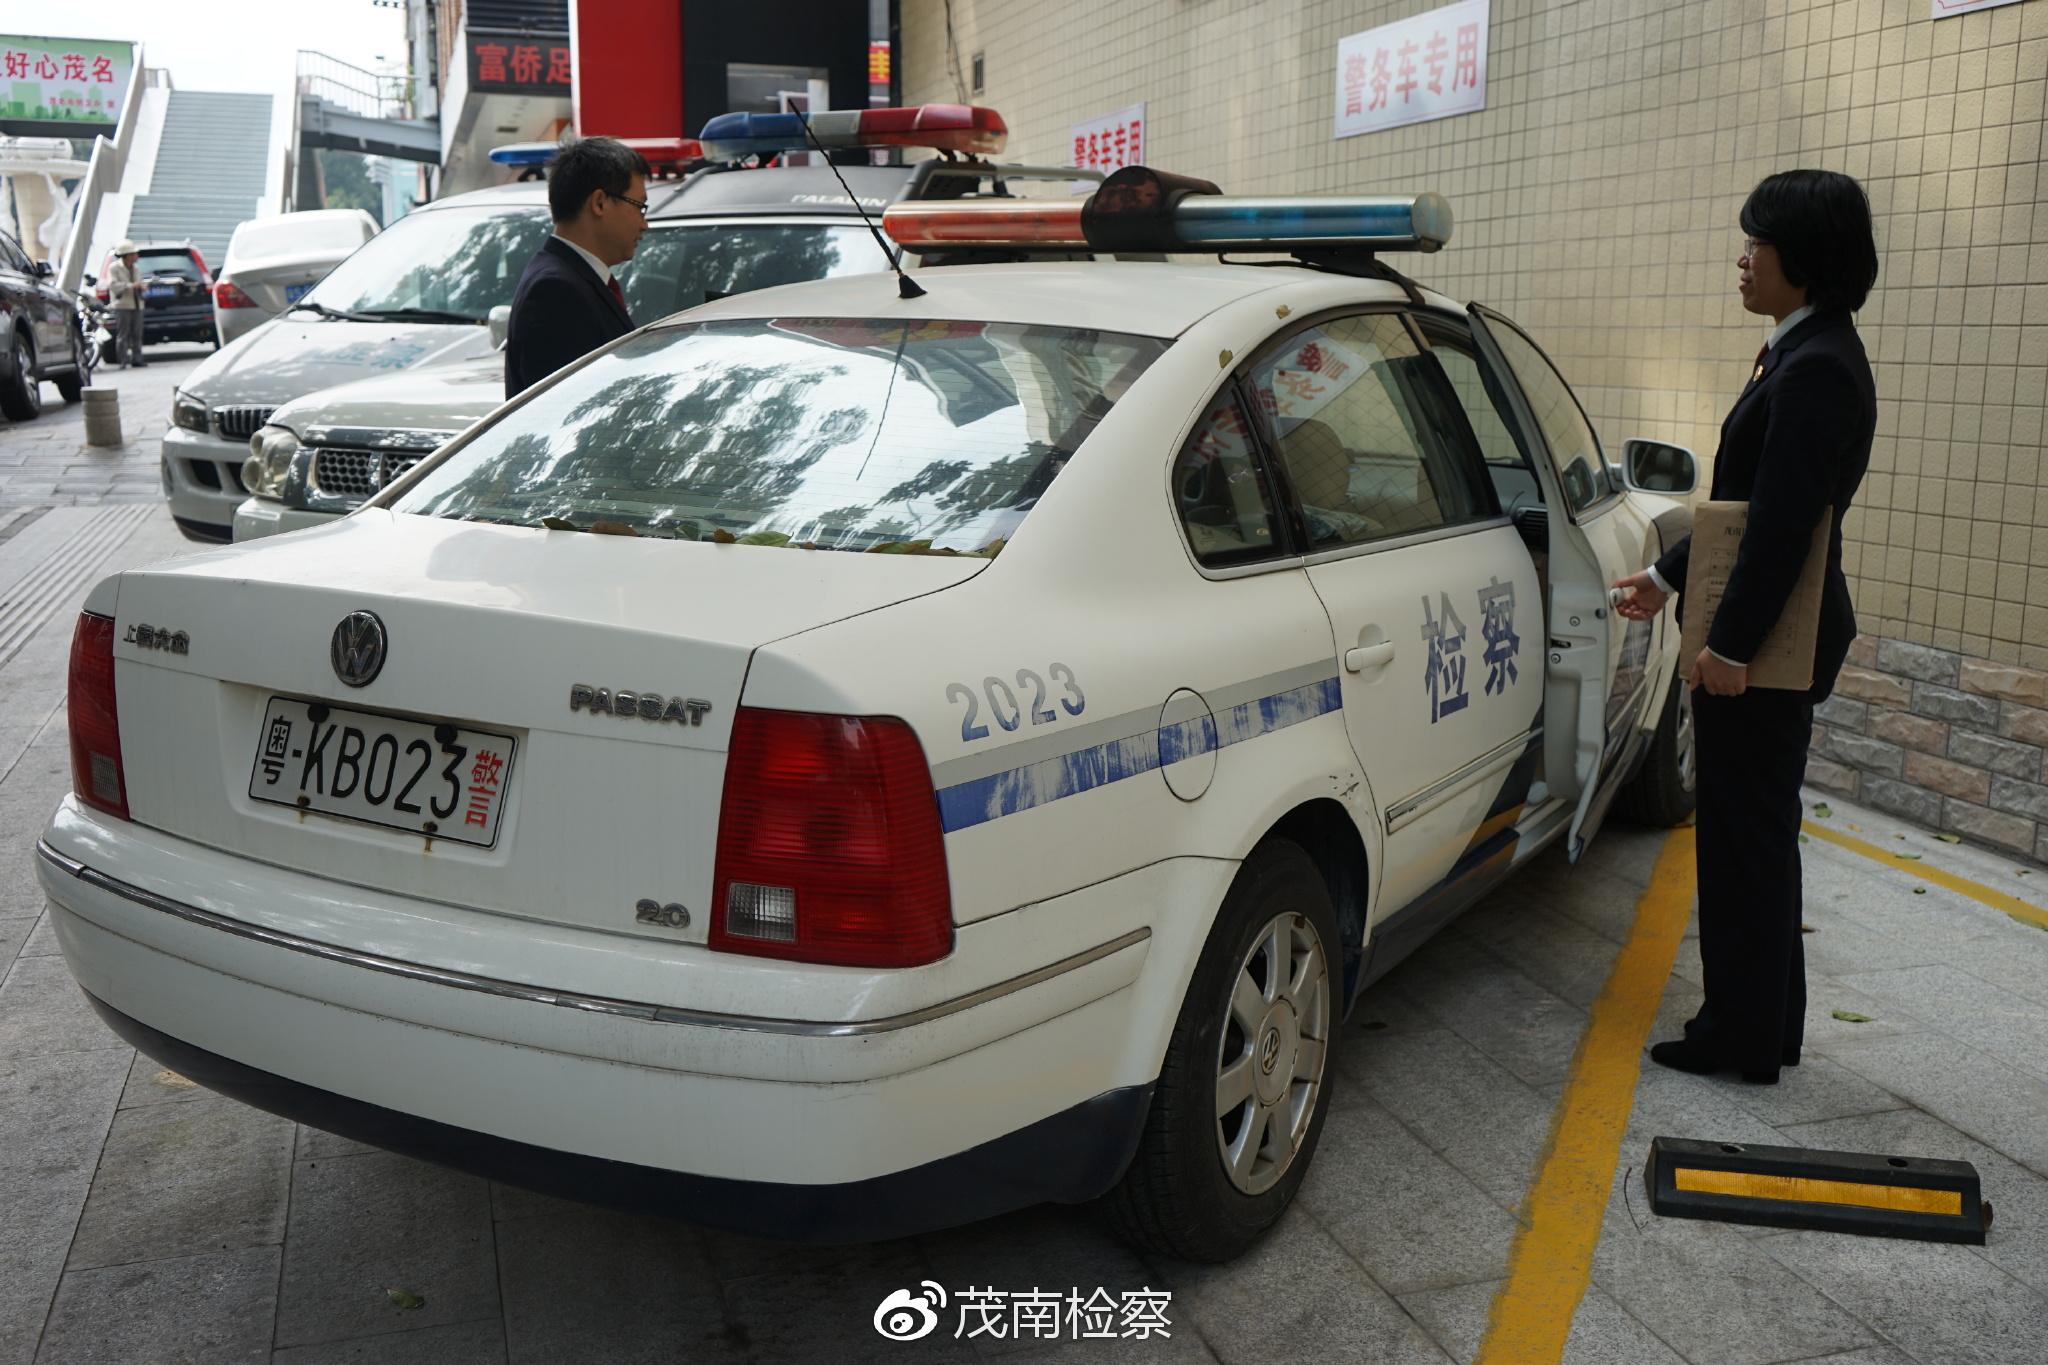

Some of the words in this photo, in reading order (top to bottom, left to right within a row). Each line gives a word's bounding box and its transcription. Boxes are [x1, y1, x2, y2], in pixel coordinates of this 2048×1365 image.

[0, 51, 114, 83] 好心茂名
[475, 43, 573, 84] 富侨足
[1344, 22, 1479, 117] 警务车专用
[1074, 120, 1141, 172] 警务车专用
[1724, 526, 1746, 537] 茂南
[1420, 575, 1520, 724] 检察
[570, 683, 712, 727] PASSAT
[946, 662, 1085, 742] 2023
